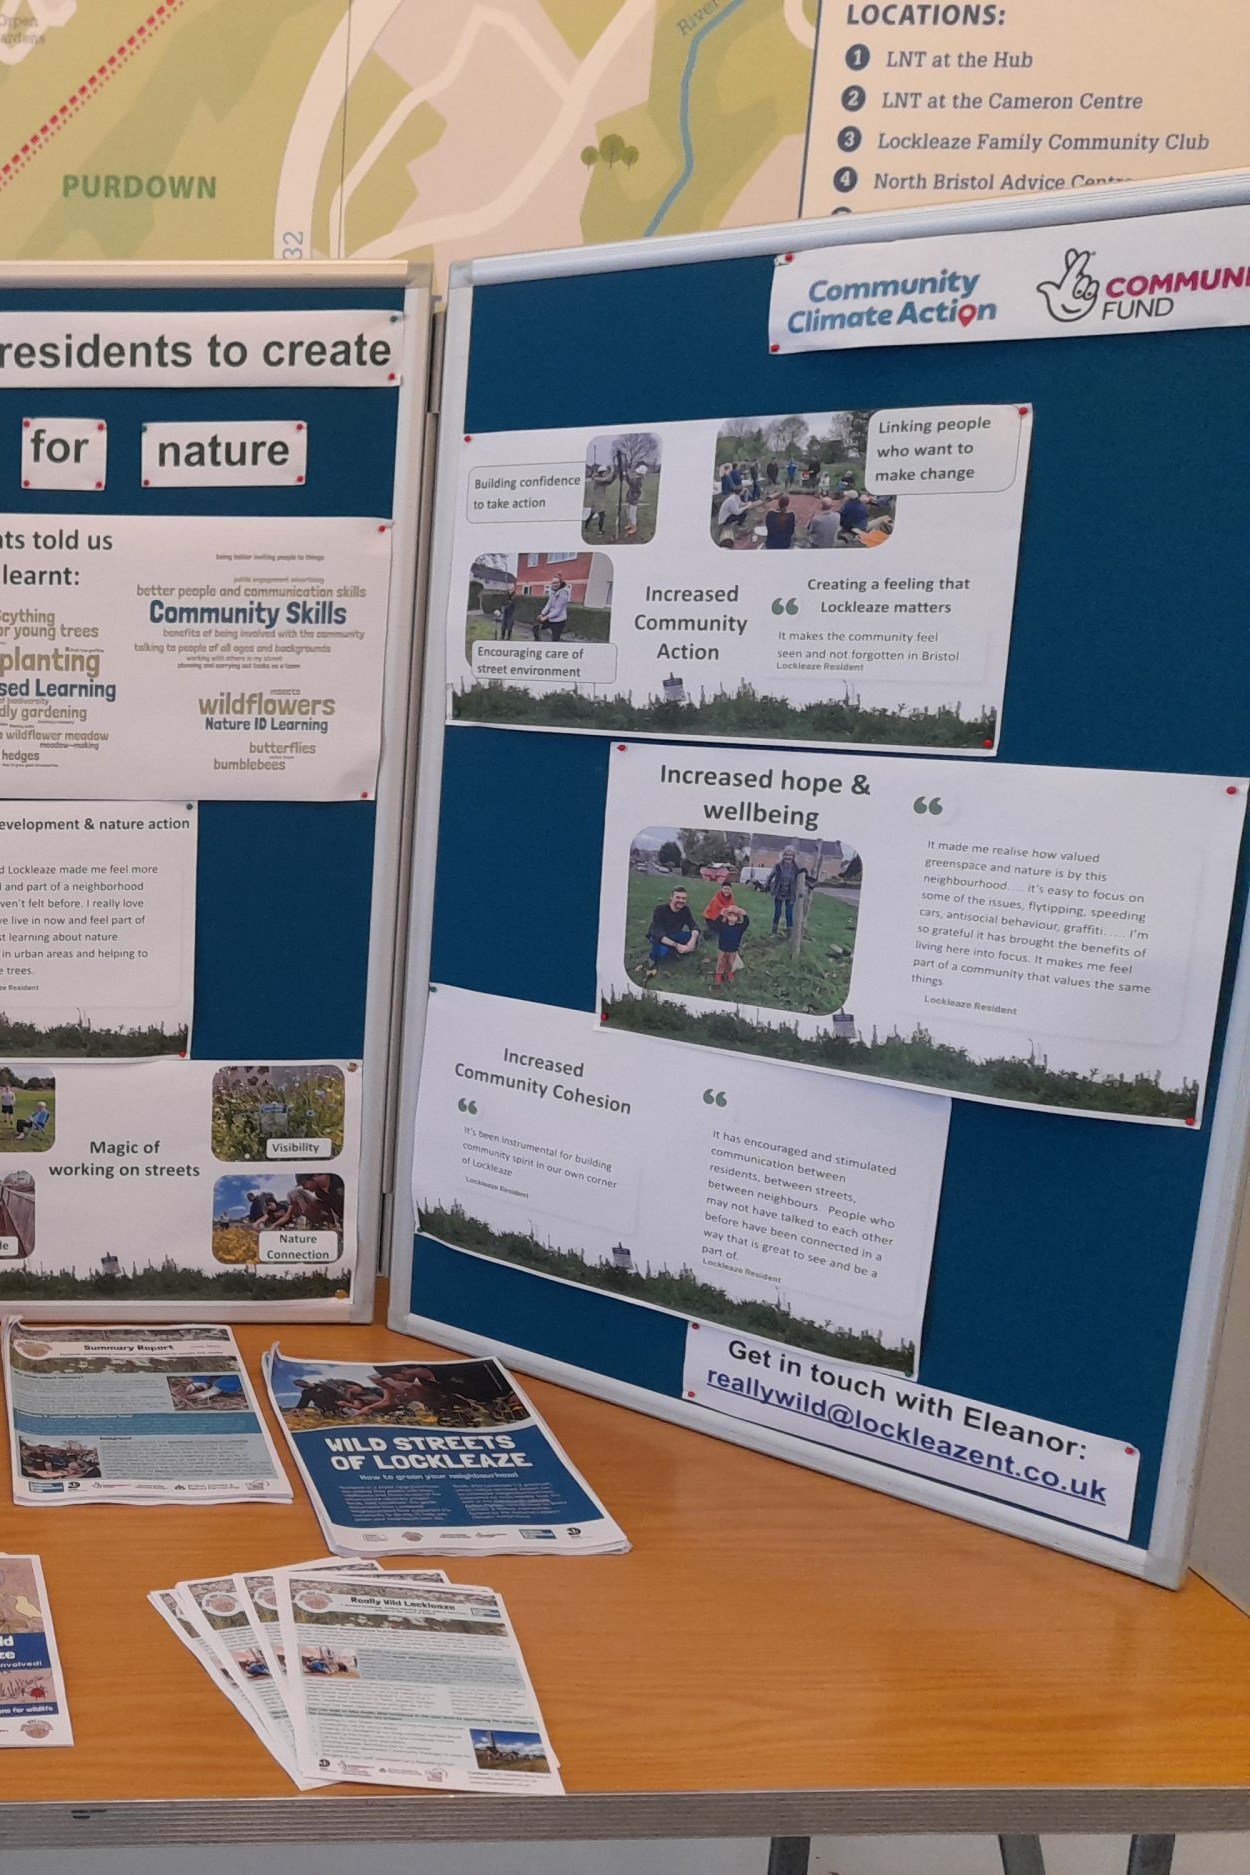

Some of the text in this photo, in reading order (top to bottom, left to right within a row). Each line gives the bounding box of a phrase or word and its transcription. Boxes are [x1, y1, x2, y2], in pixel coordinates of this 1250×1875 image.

[847, 4, 1005, 25] LOCATIONS:
[886, 51, 1032, 68] LNT at the Hub
[882, 92, 1142, 109] LNT at the Cameron Centre
[878, 133, 1209, 153] Lockleaze Family Community Club
[62, 176, 217, 199] PURDOWN
[874, 173, 926, 189] North
[933, 174, 994, 190] Bristol
[1000, 174, 1065, 190] Advice
[809, 269, 980, 306] Community
[788, 300, 997, 333] Climate Action
[1102, 298, 1173, 320] FUND
[208, 334, 247, 367] to
[263, 333, 390, 367] create
[879, 416, 990, 434] Linking people
[31, 429, 89, 463] for
[159, 435, 289, 467] nature
[877, 443, 973, 457] who want to
[876, 468, 974, 481] make change
[33, 529, 78, 550] told
[88, 536, 112, 550] us
[4, 564, 79, 585] learnt:
[646, 585, 738, 602] Increased
[150, 600, 346, 629] Community Skills
[635, 615, 748, 635] Community
[657, 643, 718, 660] Action
[36, 679, 116, 702] Learning
[198, 692, 336, 716] wildflowers
[205, 717, 329, 733] Nature ID Learning
[250, 742, 316, 754] butterflies
[214, 758, 285, 770] bumblebees
[661, 765, 870, 796] Increased hope &
[84, 818, 94, 829] &
[100, 820, 144, 829] nature
[149, 819, 189, 829] action
[704, 801, 819, 831] wellbeing
[9, 865, 56, 874] Lockleaze
[60, 865, 87, 874] made
[110, 865, 128, 873] feel
[504, 1048, 584, 1077] Increased
[455, 1063, 630, 1114] Community Cohesion
[91, 1141, 160, 1157] Magic of
[273, 1143, 319, 1153] Visibility
[49, 1163, 199, 1179] working on streets
[280, 1235, 317, 1243] Nature
[267, 1250, 329, 1259] Connection
[83, 1345, 135, 1355] Summary
[729, 1340, 1087, 1459] Get in touch with Eleanor:
[324, 1436, 516, 1452] WILD STREETS
[707, 1367, 1107, 1505] reallywild@lockleazent.co.uk
[331, 1453, 533, 1471] OF LOCKLEAZE
